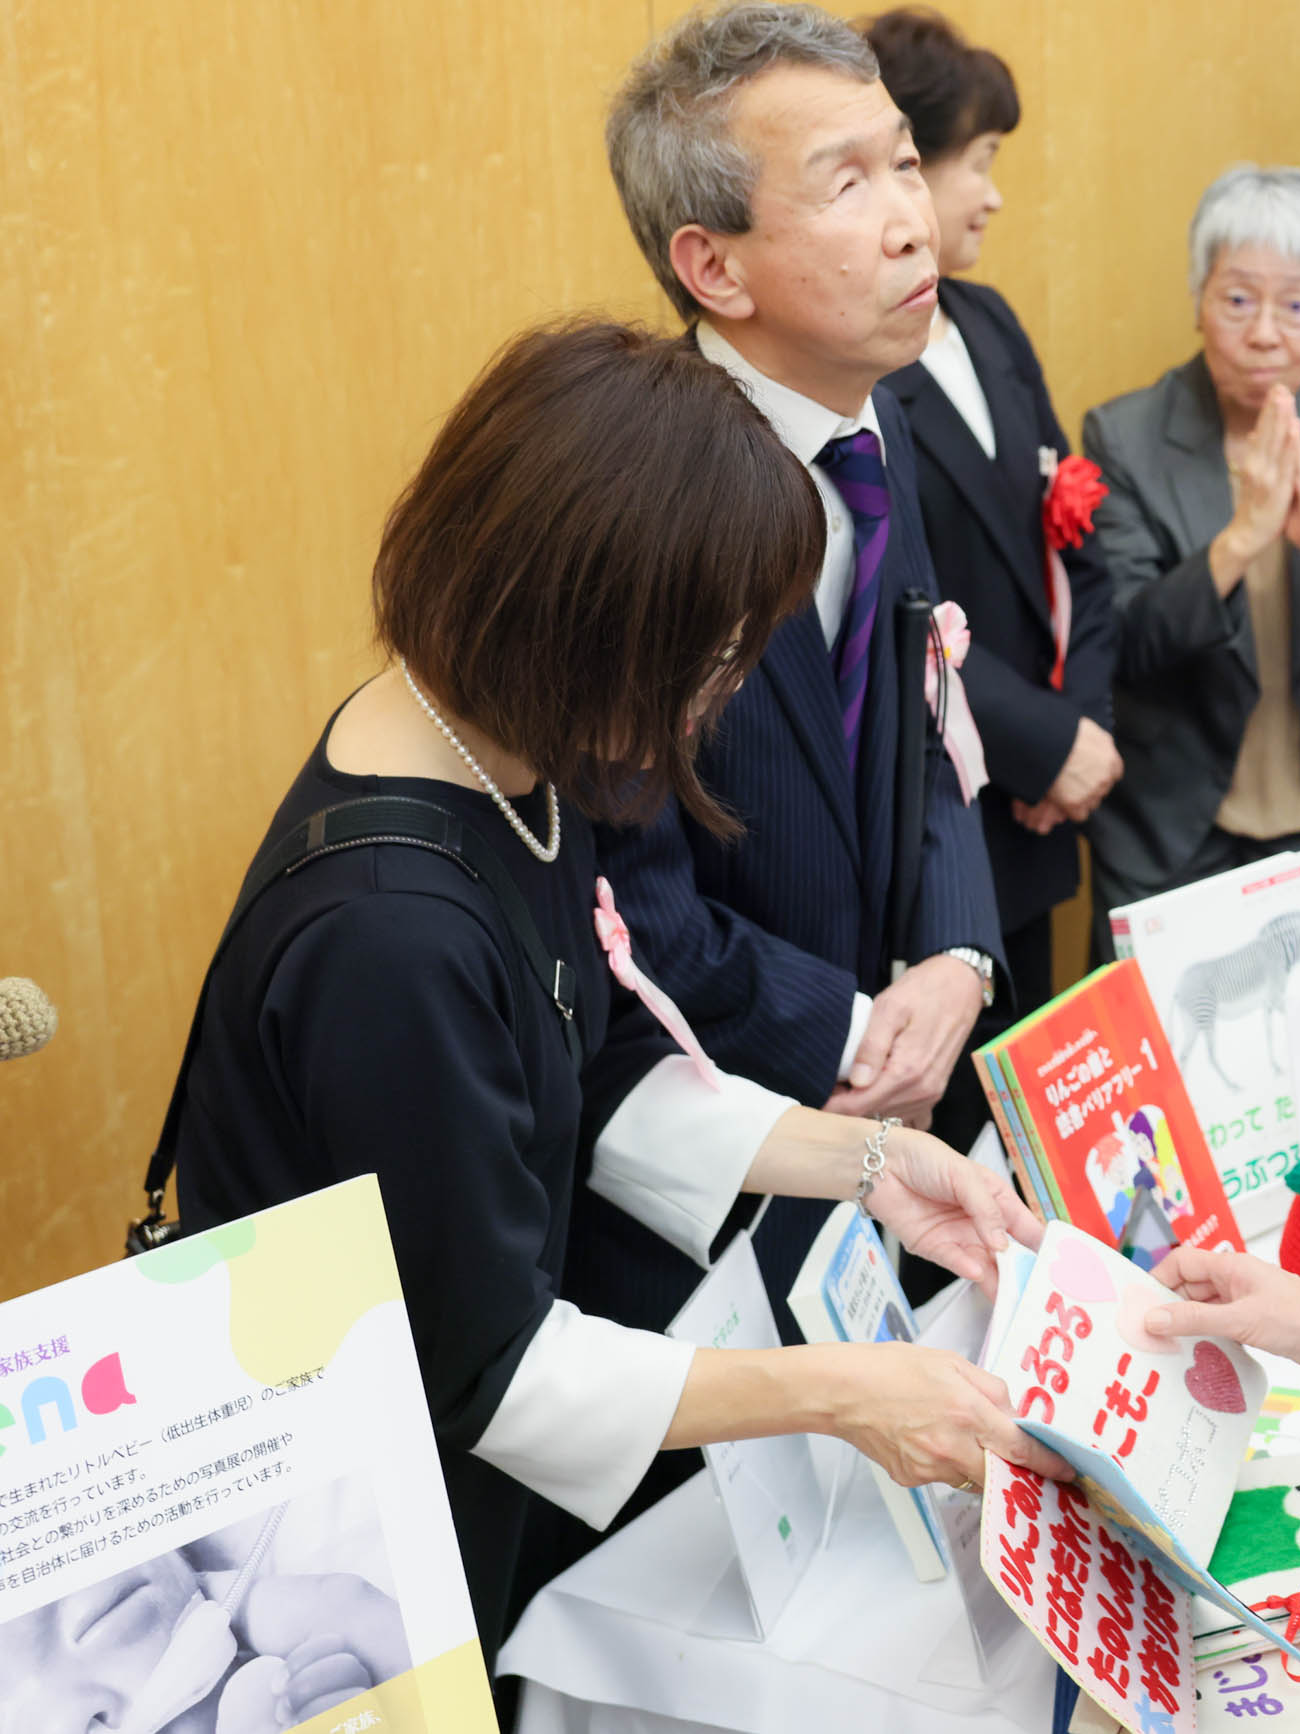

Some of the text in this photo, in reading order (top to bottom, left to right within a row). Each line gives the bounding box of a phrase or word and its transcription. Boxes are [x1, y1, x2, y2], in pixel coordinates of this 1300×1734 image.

[1015, 1291, 1094, 1425] つるつる
[1091, 1352, 1160, 1471] こもこ
